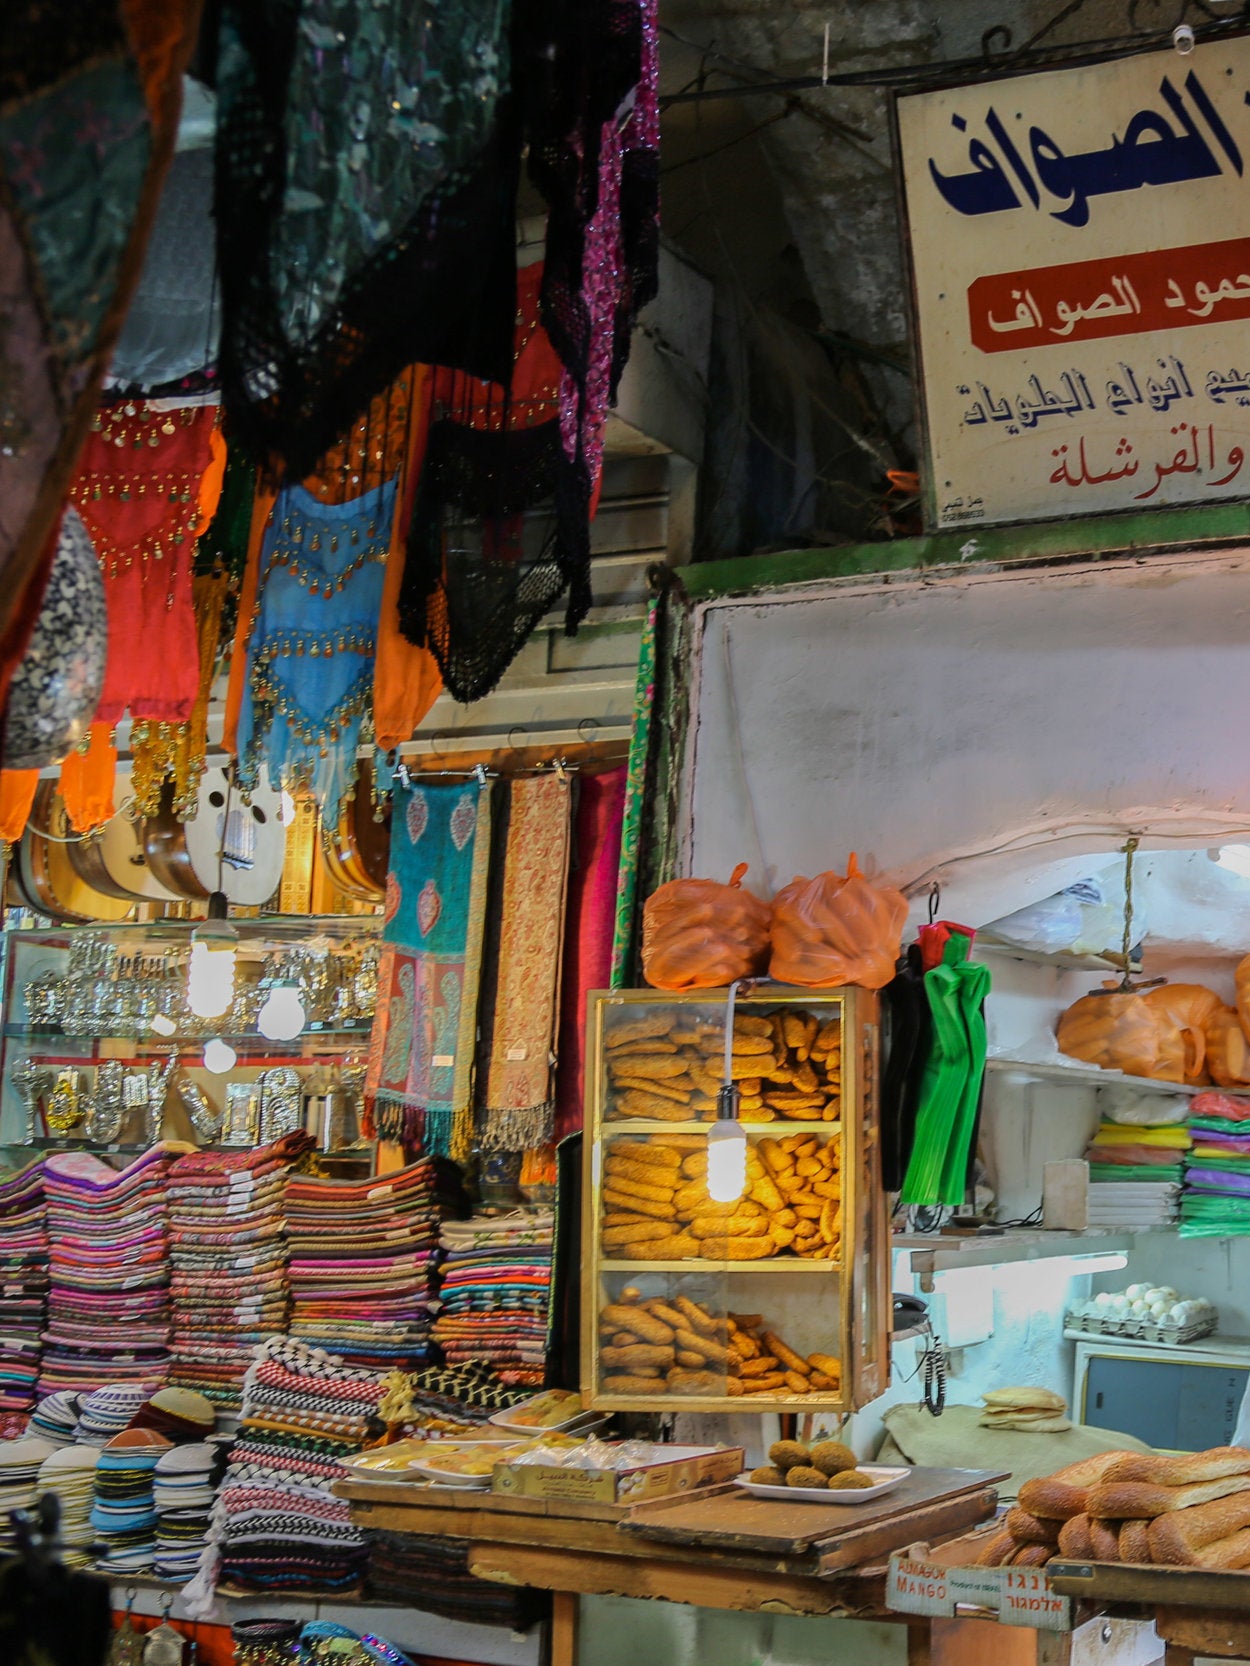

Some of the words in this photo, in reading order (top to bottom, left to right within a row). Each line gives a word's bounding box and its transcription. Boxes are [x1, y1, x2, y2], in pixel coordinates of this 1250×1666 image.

[928, 69, 1244, 227] الصواف
[987, 276, 1141, 335] الصواف
[956, 368, 1096, 434] الحلويات
[1106, 355, 1195, 415] انواع
[1050, 422, 1245, 500] والقرشلة
[897, 1576, 947, 1599] MANGO
[1006, 1595, 1063, 1612] אלמגור
